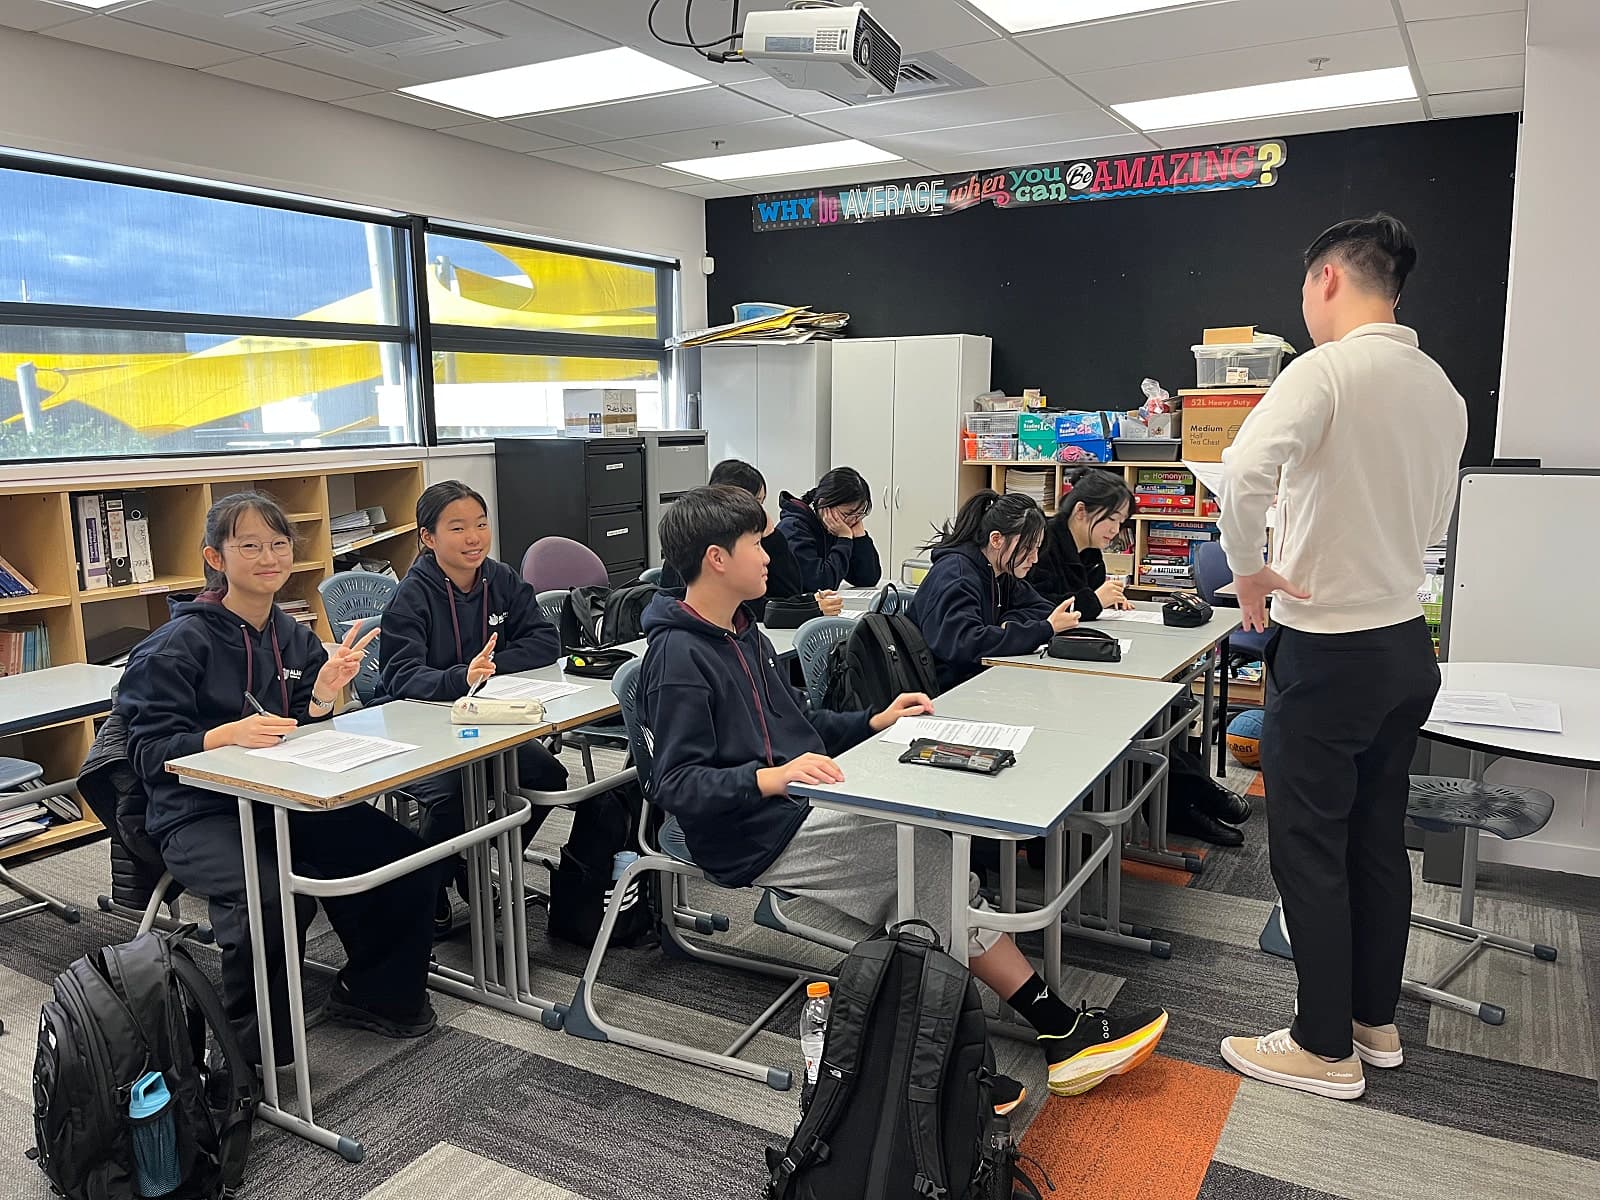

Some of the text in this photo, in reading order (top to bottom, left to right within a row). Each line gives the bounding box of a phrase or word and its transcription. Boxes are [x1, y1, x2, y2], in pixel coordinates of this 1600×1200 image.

[1009, 166, 1062, 191] you
[1067, 164, 1093, 186] Be
[844, 179, 945, 220] AVERAGE
[950, 174, 1006, 204] when
[1015, 182, 1067, 201] can
[757, 197, 816, 223] WHY
[818, 190, 839, 224] be
[1191, 398, 1251, 407] 52L Heavy Duty
[1230, 743, 1253, 753] olten
